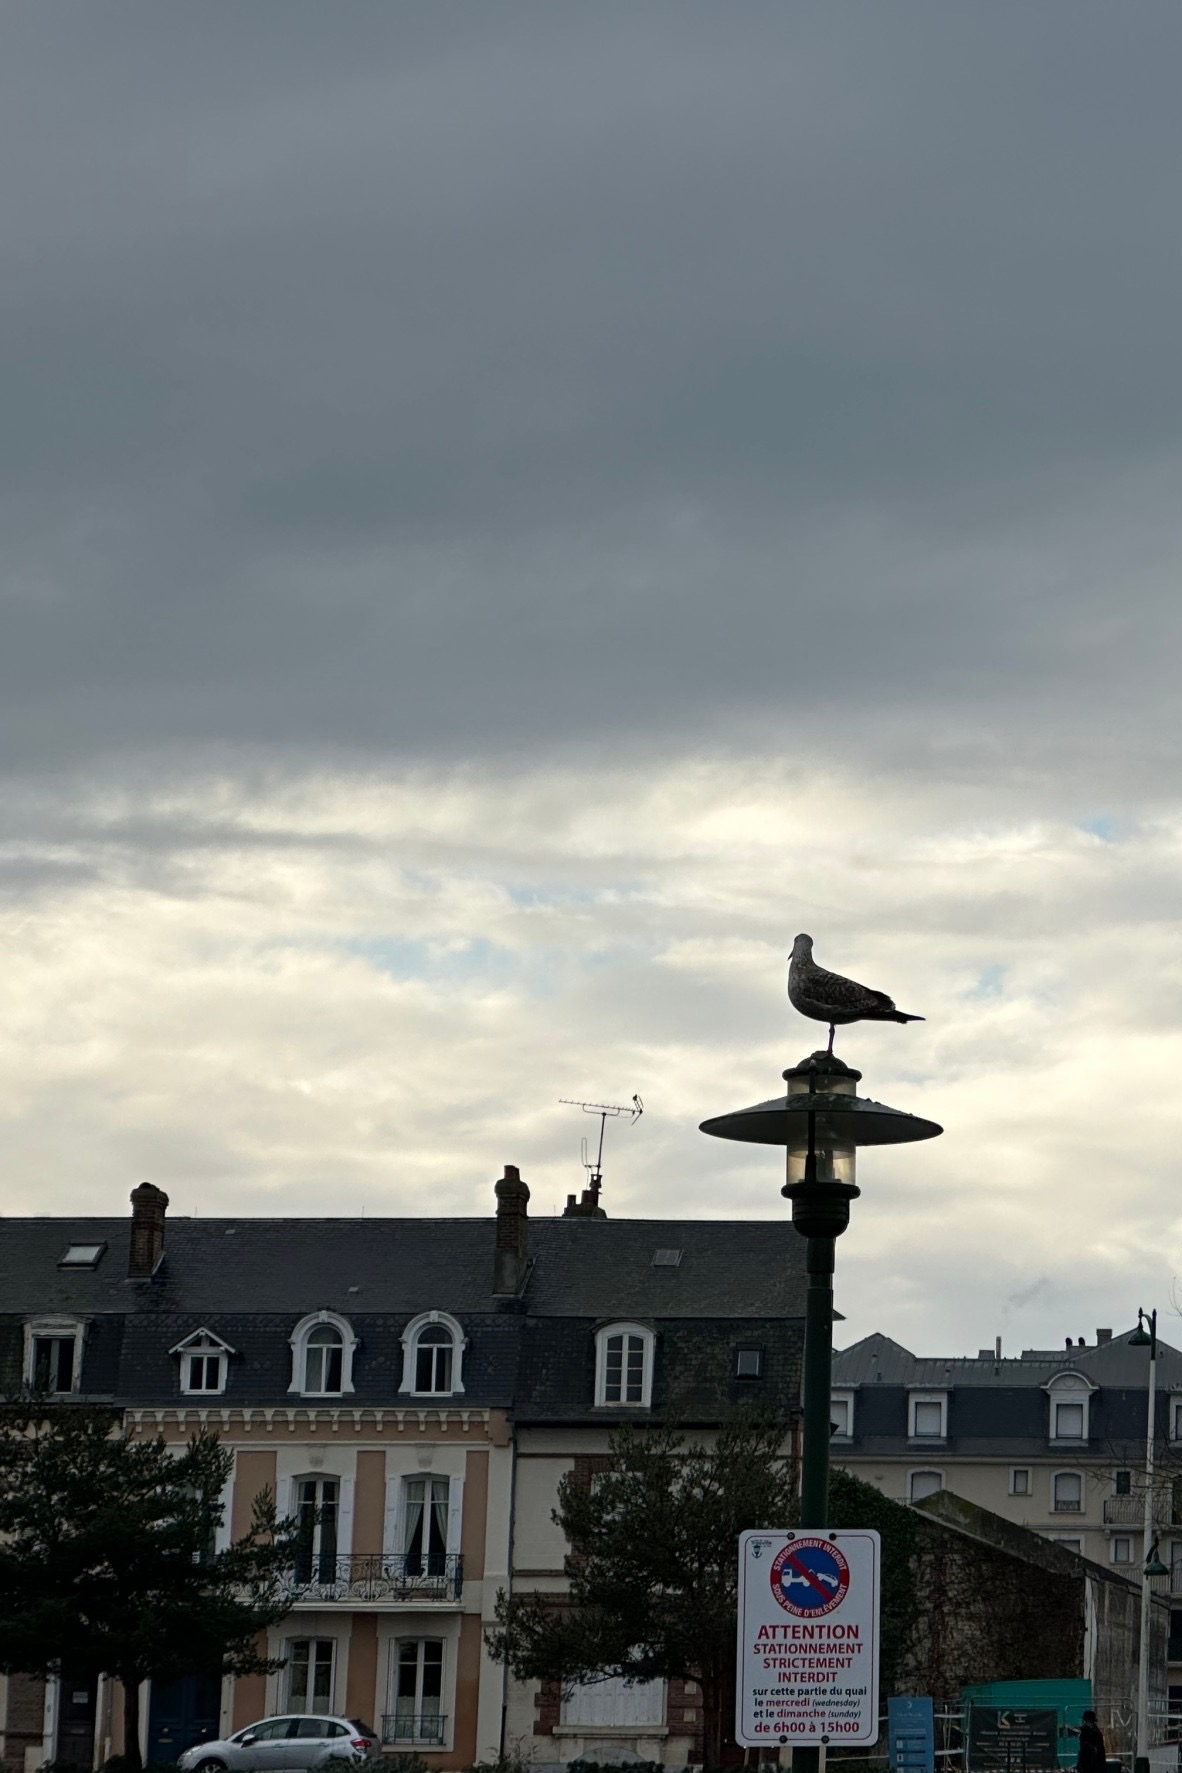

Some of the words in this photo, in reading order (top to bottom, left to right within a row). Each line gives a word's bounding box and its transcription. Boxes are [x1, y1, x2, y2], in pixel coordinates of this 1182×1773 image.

[773, 1540, 823, 1571] STATIONNEMENT
[823, 1543, 847, 1571] INTERDIT
[772, 1583, 785, 1603] SOUS
[782, 1600, 803, 1616] PEINE
[757, 1625, 859, 1640] ATTENTION
[753, 1643, 863, 1655] STATIONNEMENT
[763, 1657, 853, 1669] STRICTEMENT
[778, 1671, 838, 1683] INTERDIT
[752, 1688, 768, 1696] sur
[770, 1687, 796, 1696] cette
[797, 1686, 827, 1697] partie
[829, 1686, 842, 1696] du
[844, 1686, 867, 1698] quai
[754, 1698, 764, 1707] le
[766, 1698, 810, 1707] mercredi
[812, 1699, 860, 1708] (wednesday)
[753, 1710, 764, 1718] et
[765, 1709, 775, 1718] le
[777, 1709, 826, 1718] dimanche
[827, 1711, 861, 1719] (sunday)
[754, 1721, 771, 1733] de
[773, 1722, 806, 1733] 6h00
[808, 1721, 817, 1733] à
[820, 1722, 860, 1733] 15h00
